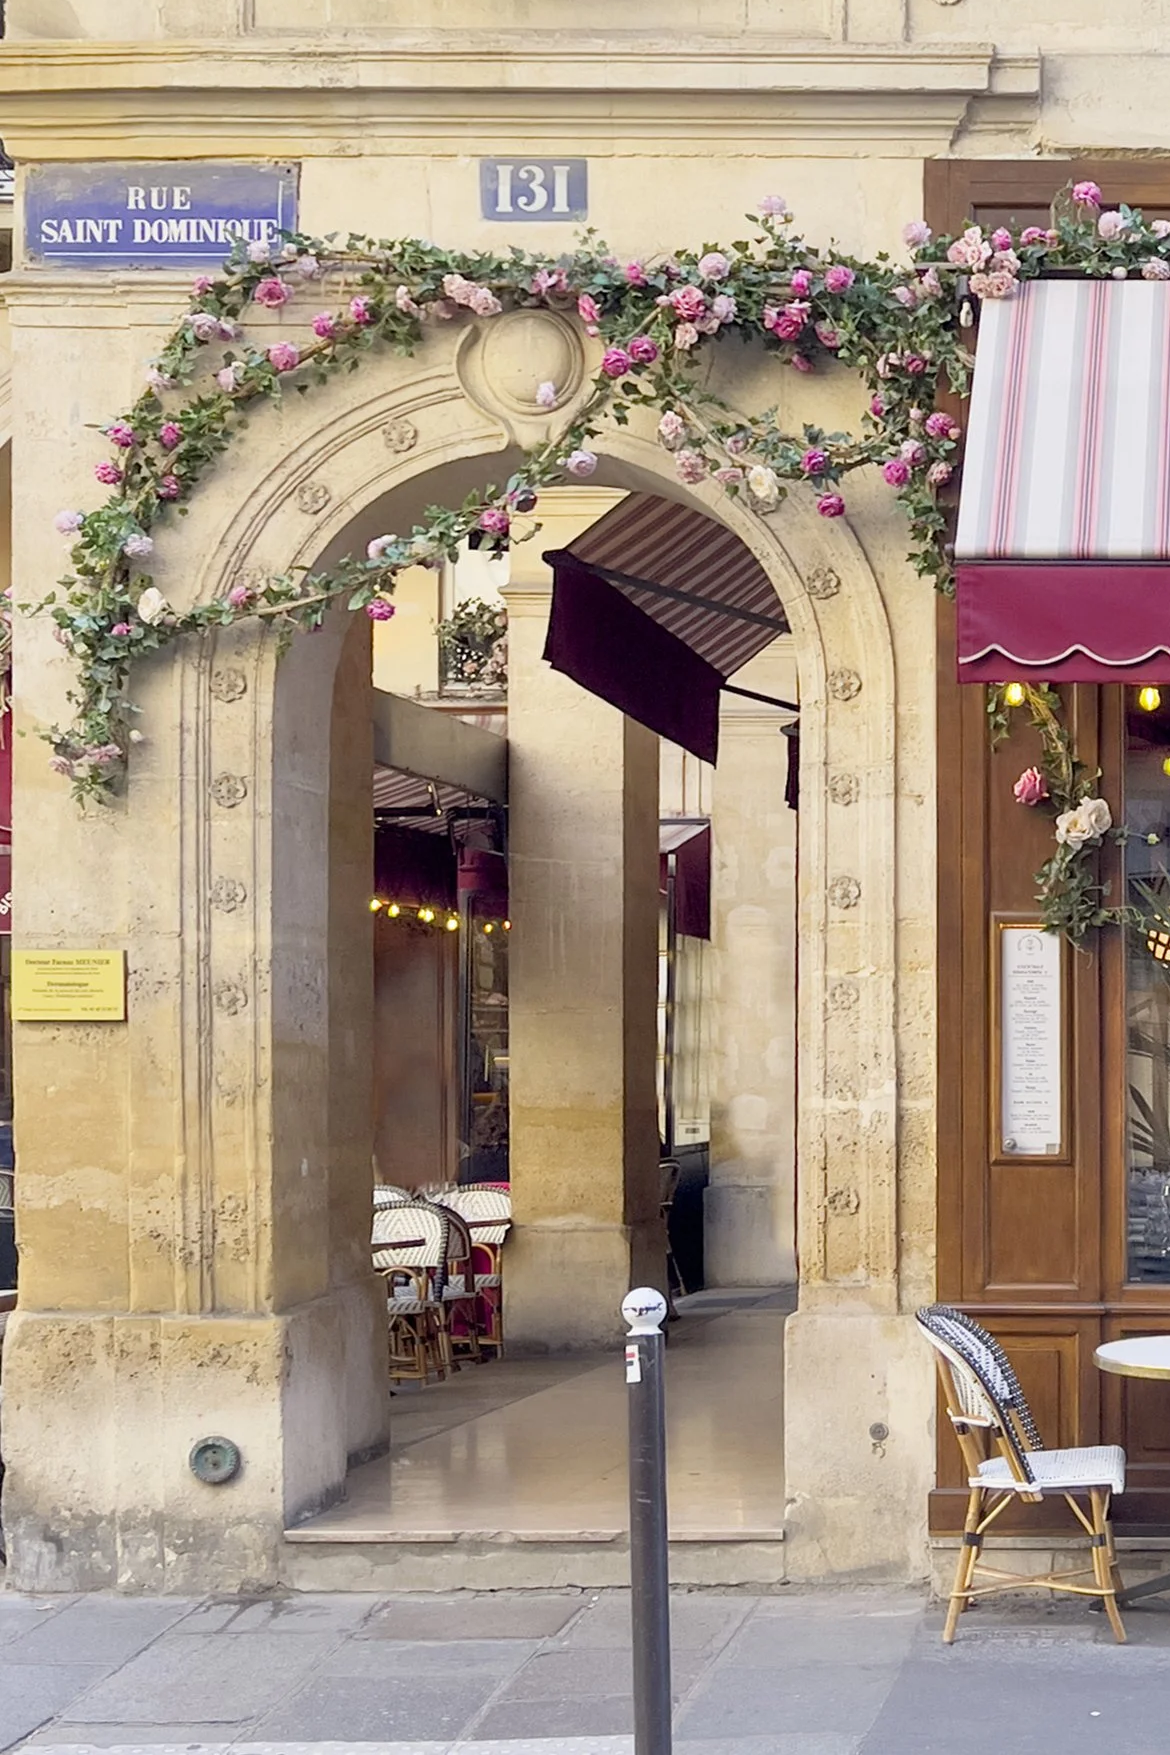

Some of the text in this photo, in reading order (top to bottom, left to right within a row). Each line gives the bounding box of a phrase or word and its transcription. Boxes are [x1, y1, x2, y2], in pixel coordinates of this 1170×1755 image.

[127, 186, 192, 211] RUE
[496, 164, 570, 213] 131
[40, 218, 278, 244] SAINT DOMINIQUE
